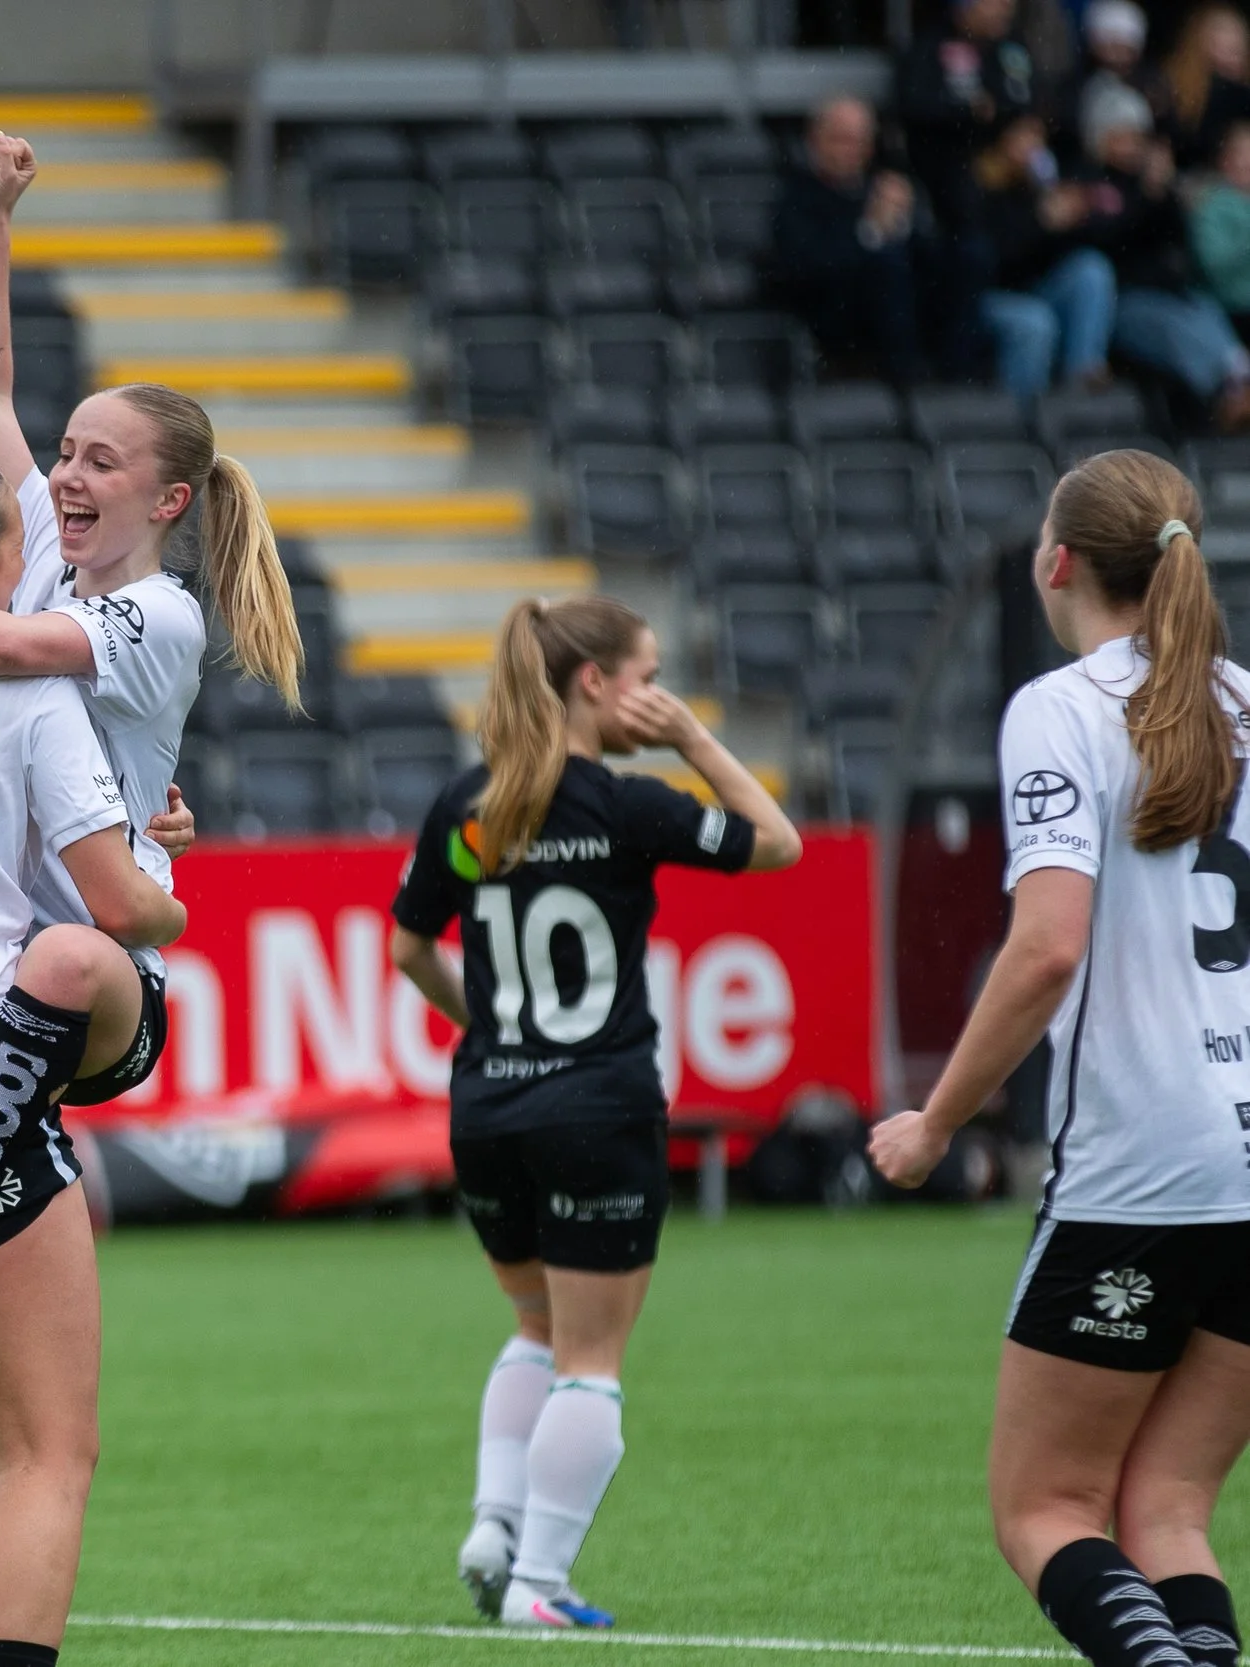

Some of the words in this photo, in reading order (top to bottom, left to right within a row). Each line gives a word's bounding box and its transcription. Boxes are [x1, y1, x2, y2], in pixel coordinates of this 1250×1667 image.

[1046, 828, 1093, 852] Sogn
[475, 883, 619, 1046] 10
[1204, 1028, 1244, 1064] Hov
[1070, 1315, 1149, 1341] mesta
